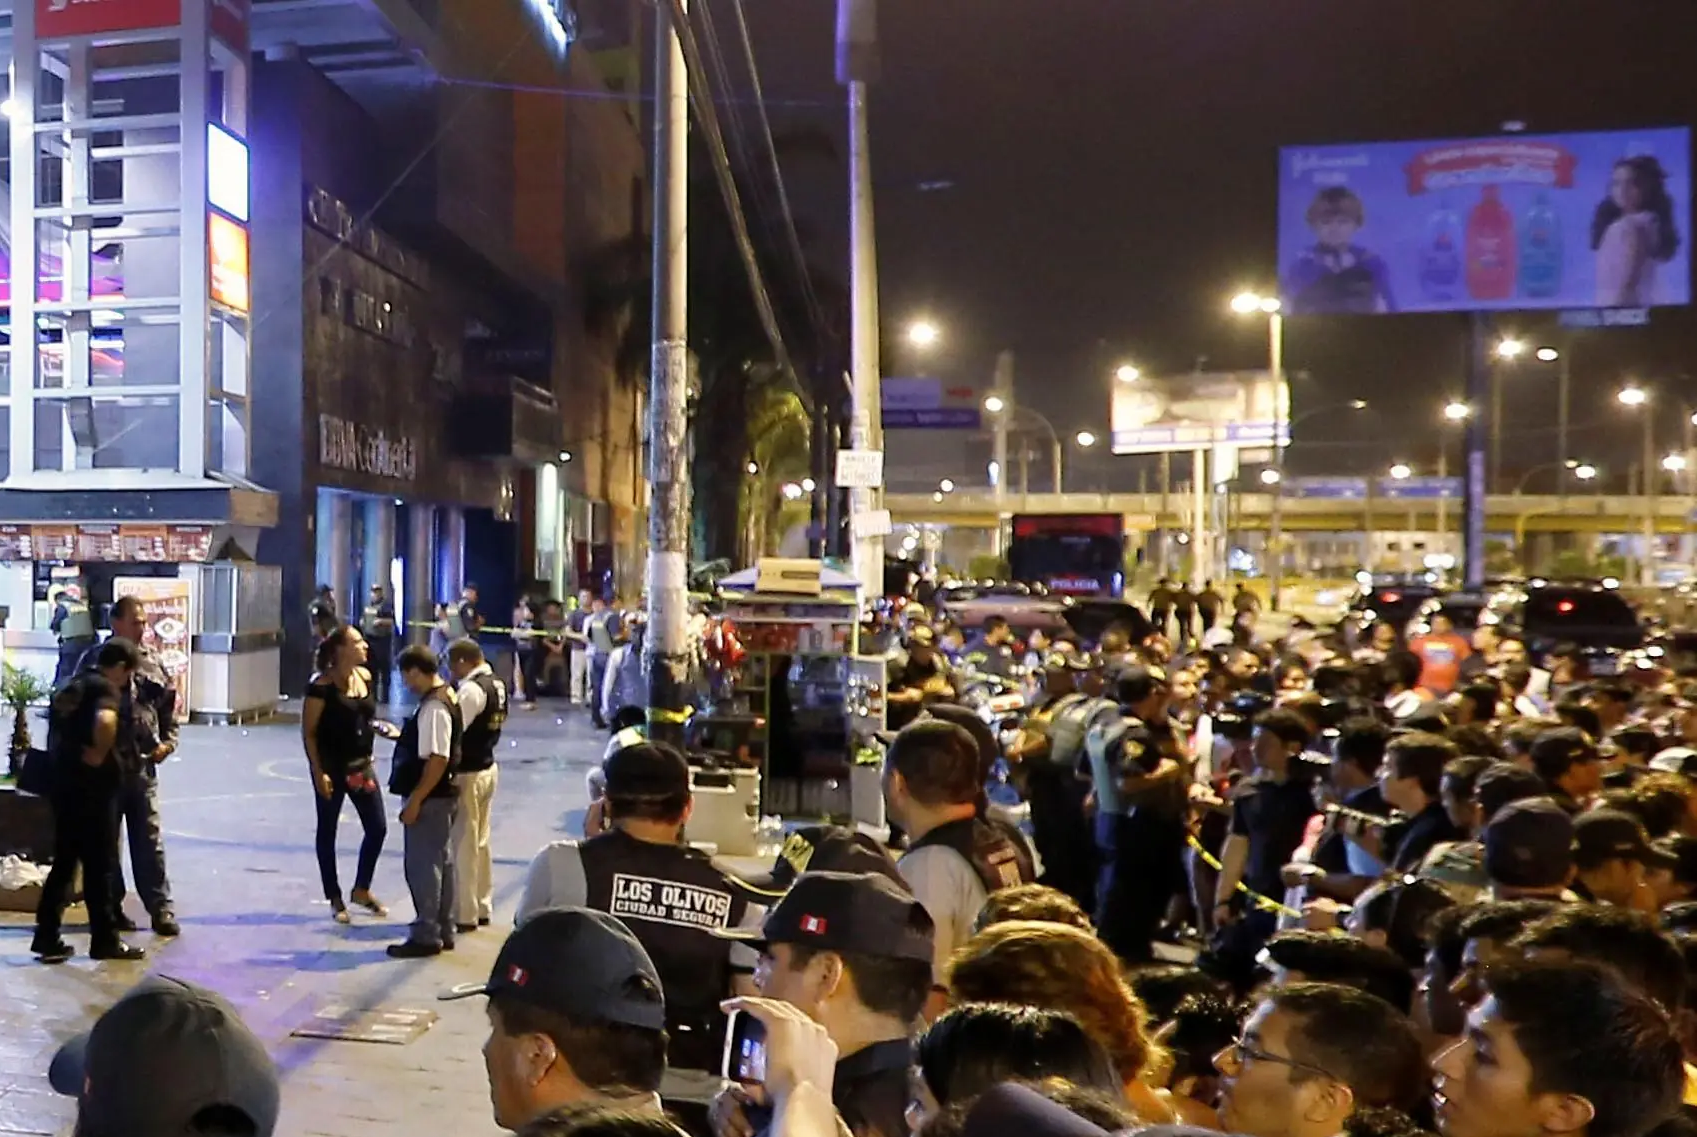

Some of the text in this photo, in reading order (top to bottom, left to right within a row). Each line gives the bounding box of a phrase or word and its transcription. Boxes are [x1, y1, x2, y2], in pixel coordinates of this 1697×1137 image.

[615, 899, 722, 928] CIUDAD SEGURA
[617, 879, 727, 917] LOS OLIVOS
